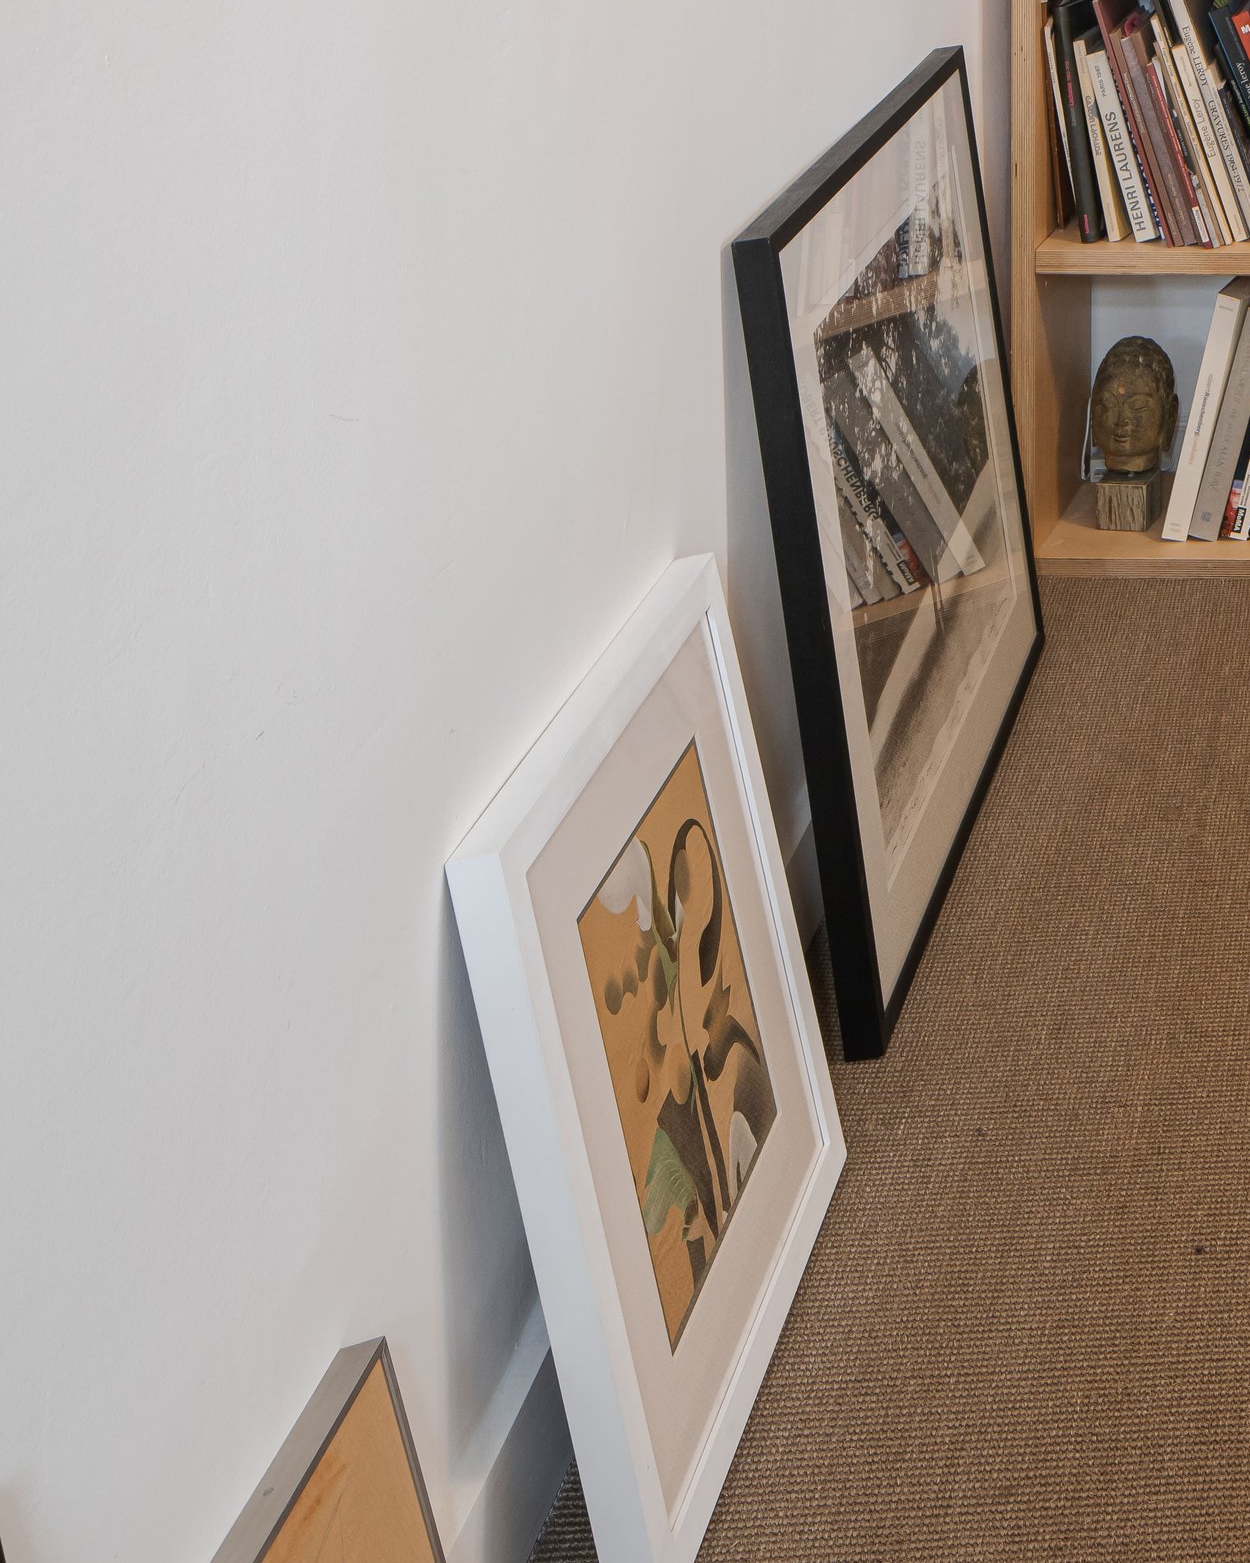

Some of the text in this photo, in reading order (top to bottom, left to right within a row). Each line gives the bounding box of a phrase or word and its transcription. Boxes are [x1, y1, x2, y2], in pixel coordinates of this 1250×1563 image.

[1181, 25, 1209, 87] Eugène LEROY
[1105, 111, 1147, 231] HENRI LAURENS
[1233, 508, 1245, 531] MoMA
